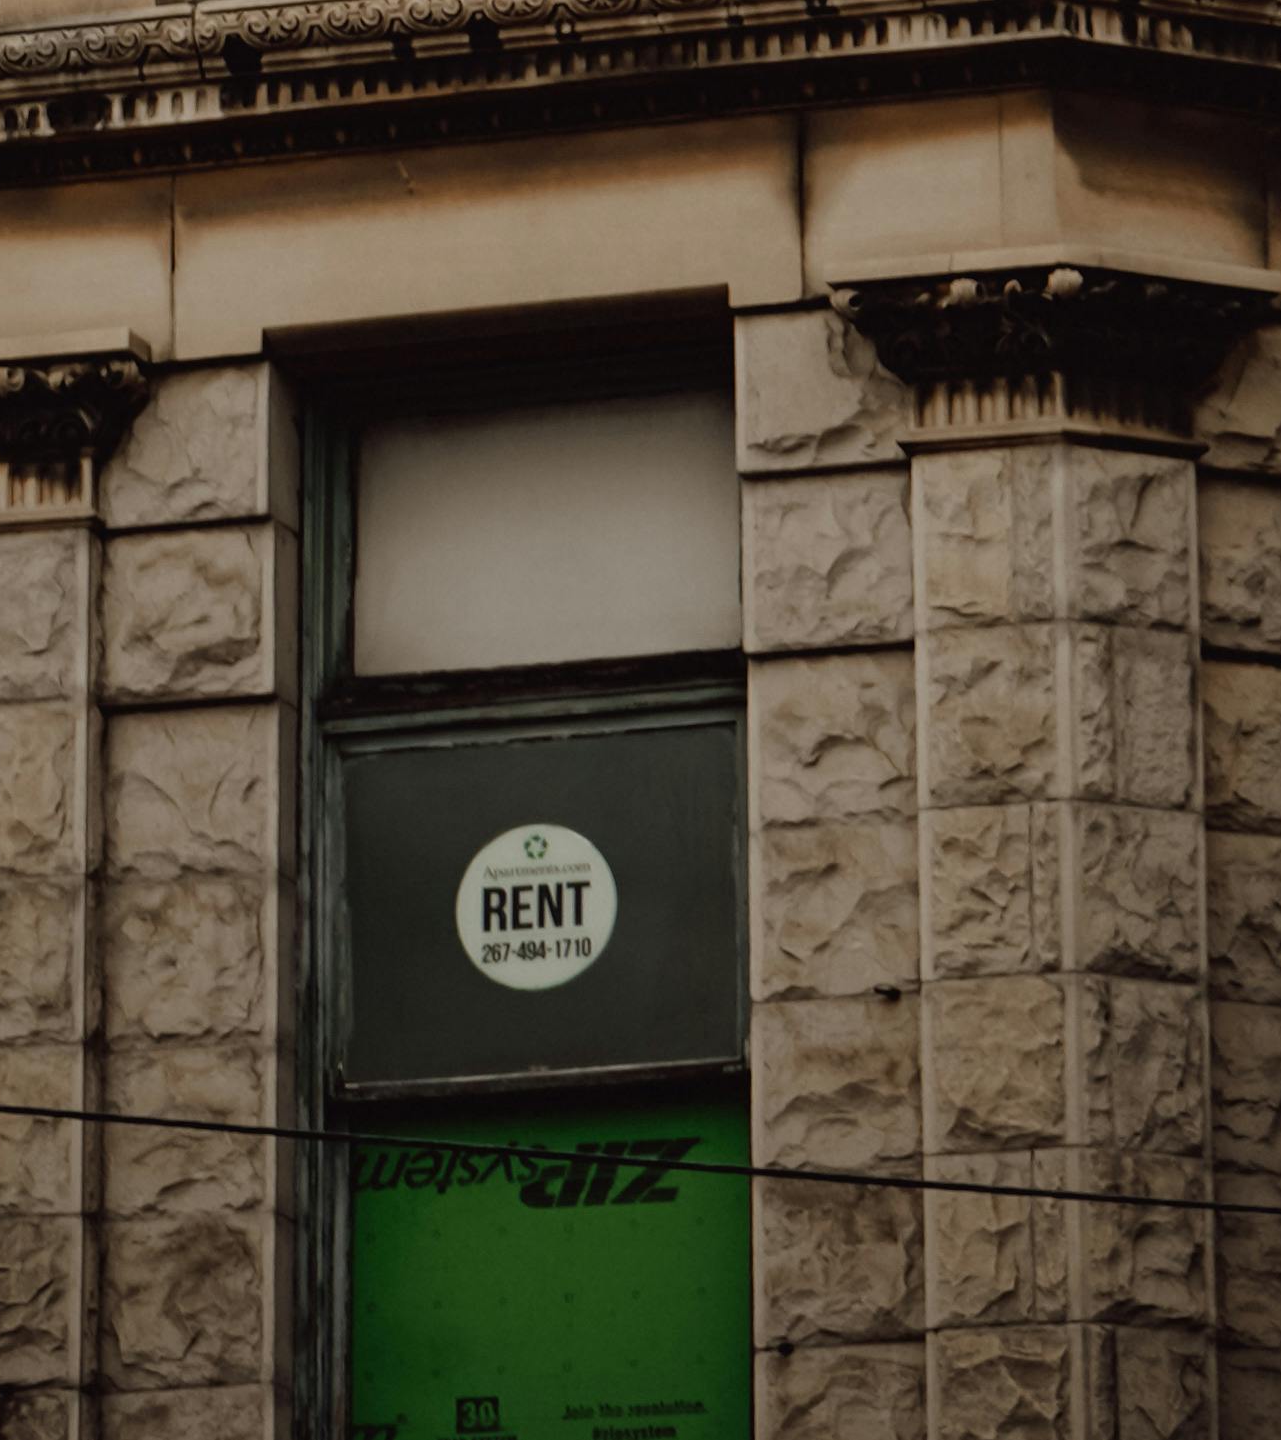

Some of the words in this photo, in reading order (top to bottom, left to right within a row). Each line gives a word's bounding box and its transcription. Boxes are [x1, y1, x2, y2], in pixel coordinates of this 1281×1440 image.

[483, 881, 591, 932] RENT
[482, 936, 593, 964] 267-494-1710
[461, 1400, 498, 1429] 30
